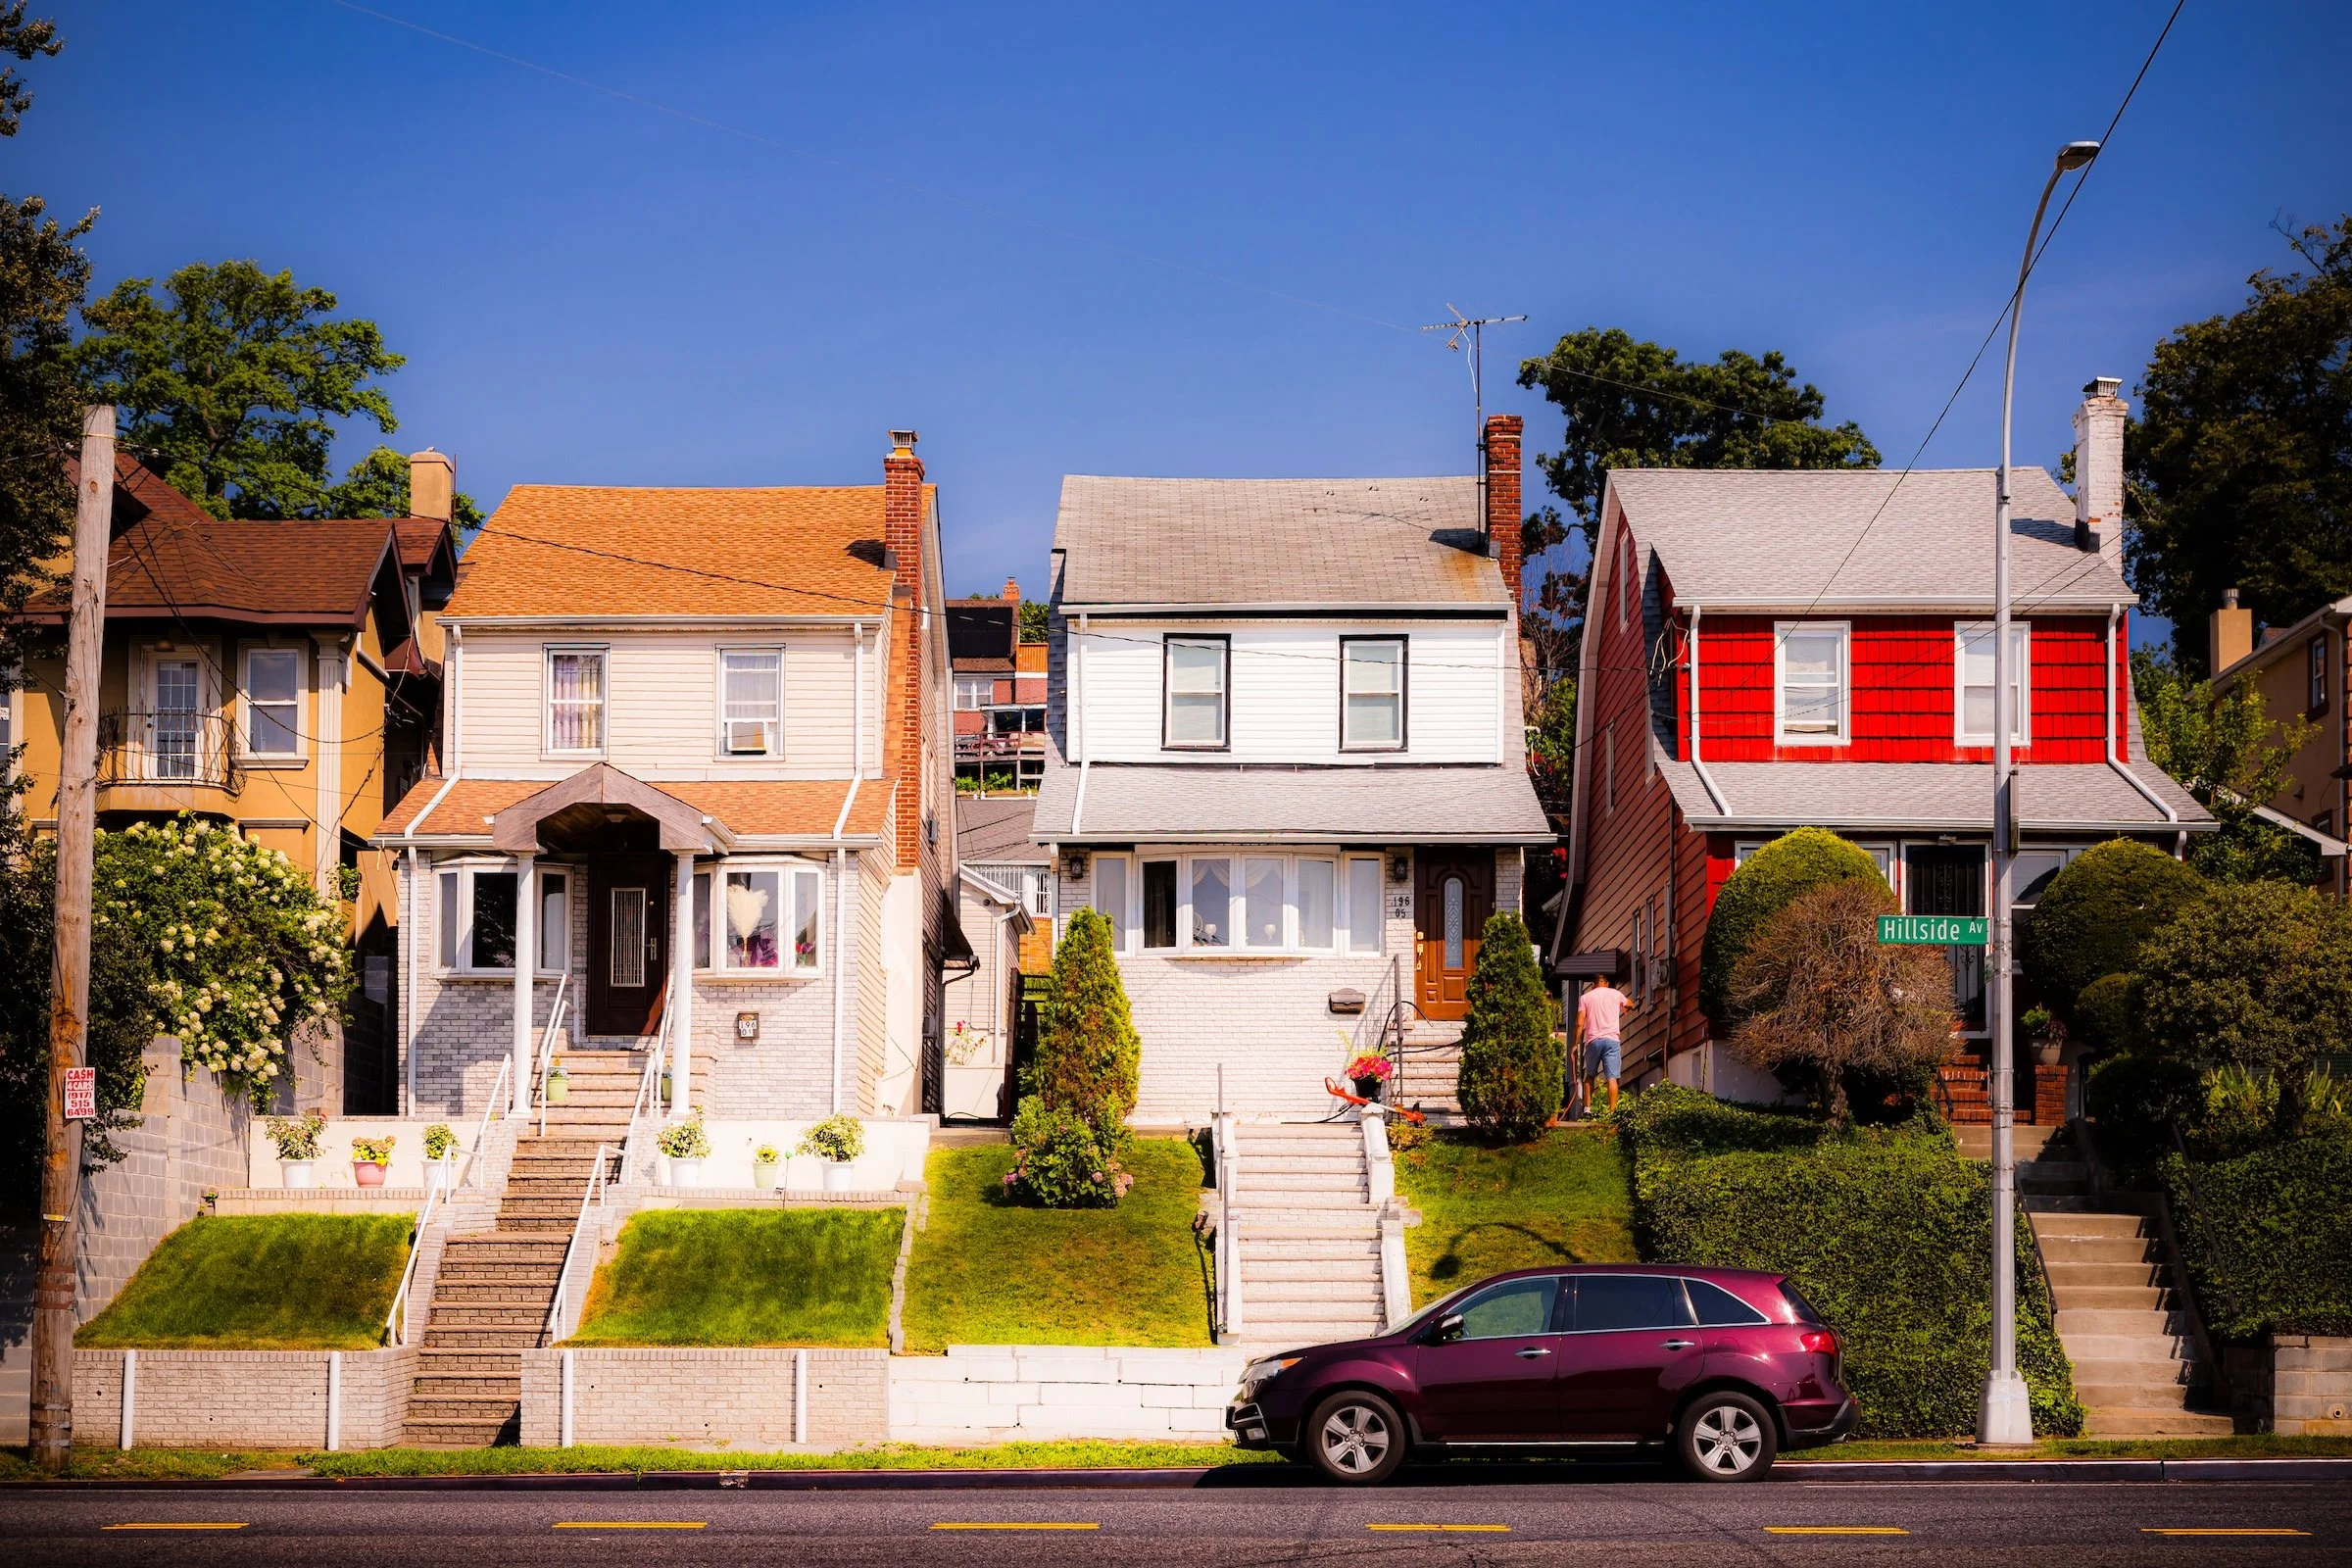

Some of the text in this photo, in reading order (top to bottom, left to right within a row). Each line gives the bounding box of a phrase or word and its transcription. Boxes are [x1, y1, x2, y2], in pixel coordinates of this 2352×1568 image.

[1394, 896, 1410, 906] 196
[1396, 908, 1405, 918] 05
[1885, 918, 1983, 941] Hillside Av
[68, 1091, 92, 1100] (917)
[71, 1100, 90, 1108] 515
[68, 1107, 94, 1116] 6499
